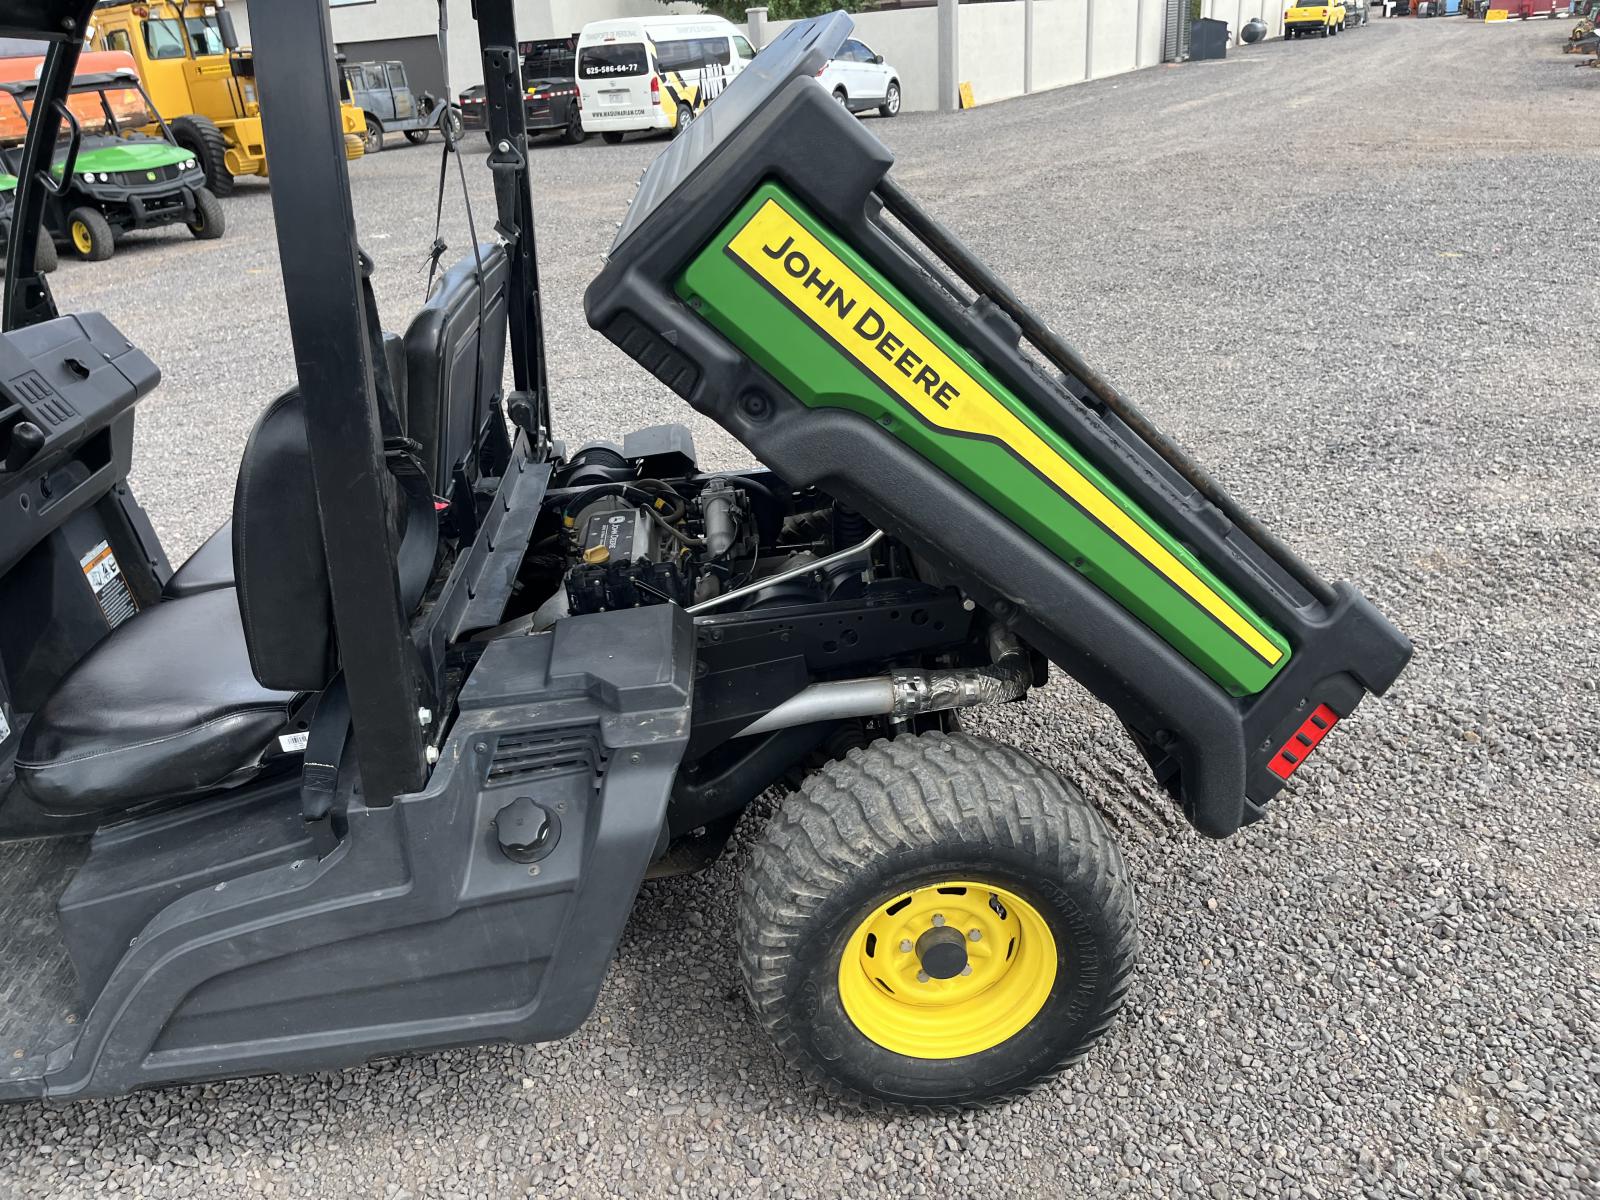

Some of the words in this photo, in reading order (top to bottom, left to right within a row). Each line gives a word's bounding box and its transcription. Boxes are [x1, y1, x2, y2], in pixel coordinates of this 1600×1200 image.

[586, 63, 638, 75] 625-586-64-77
[762, 236, 857, 320] JOHN
[852, 307, 961, 411] DEERE
